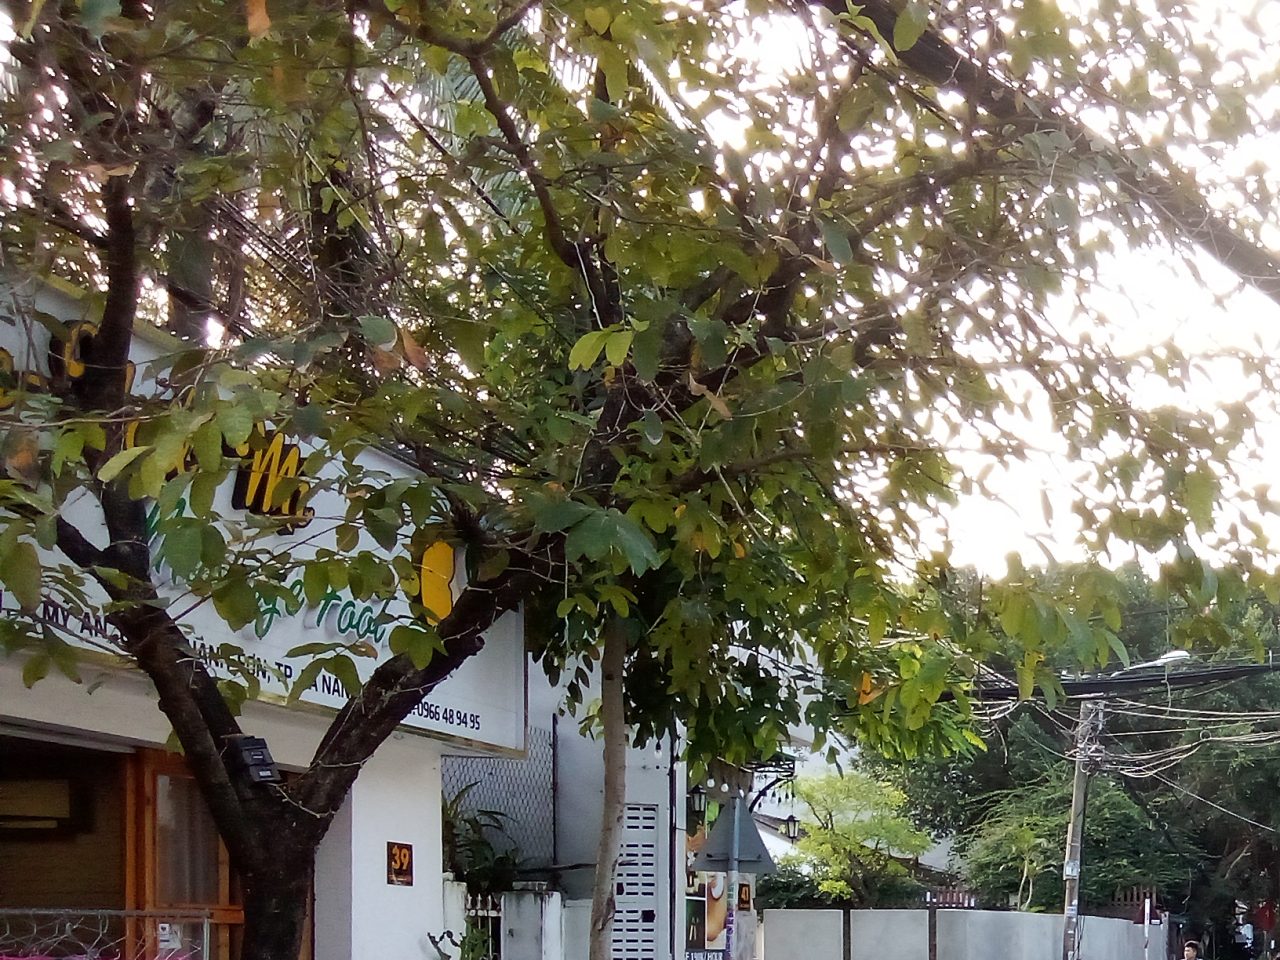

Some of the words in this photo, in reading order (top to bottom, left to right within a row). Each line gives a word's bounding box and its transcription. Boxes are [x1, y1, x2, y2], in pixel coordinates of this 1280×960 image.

[442, 708, 454, 724] 48
[456, 711, 467, 728] 94
[469, 714, 480, 730] 95
[391, 845, 409, 870] 39
